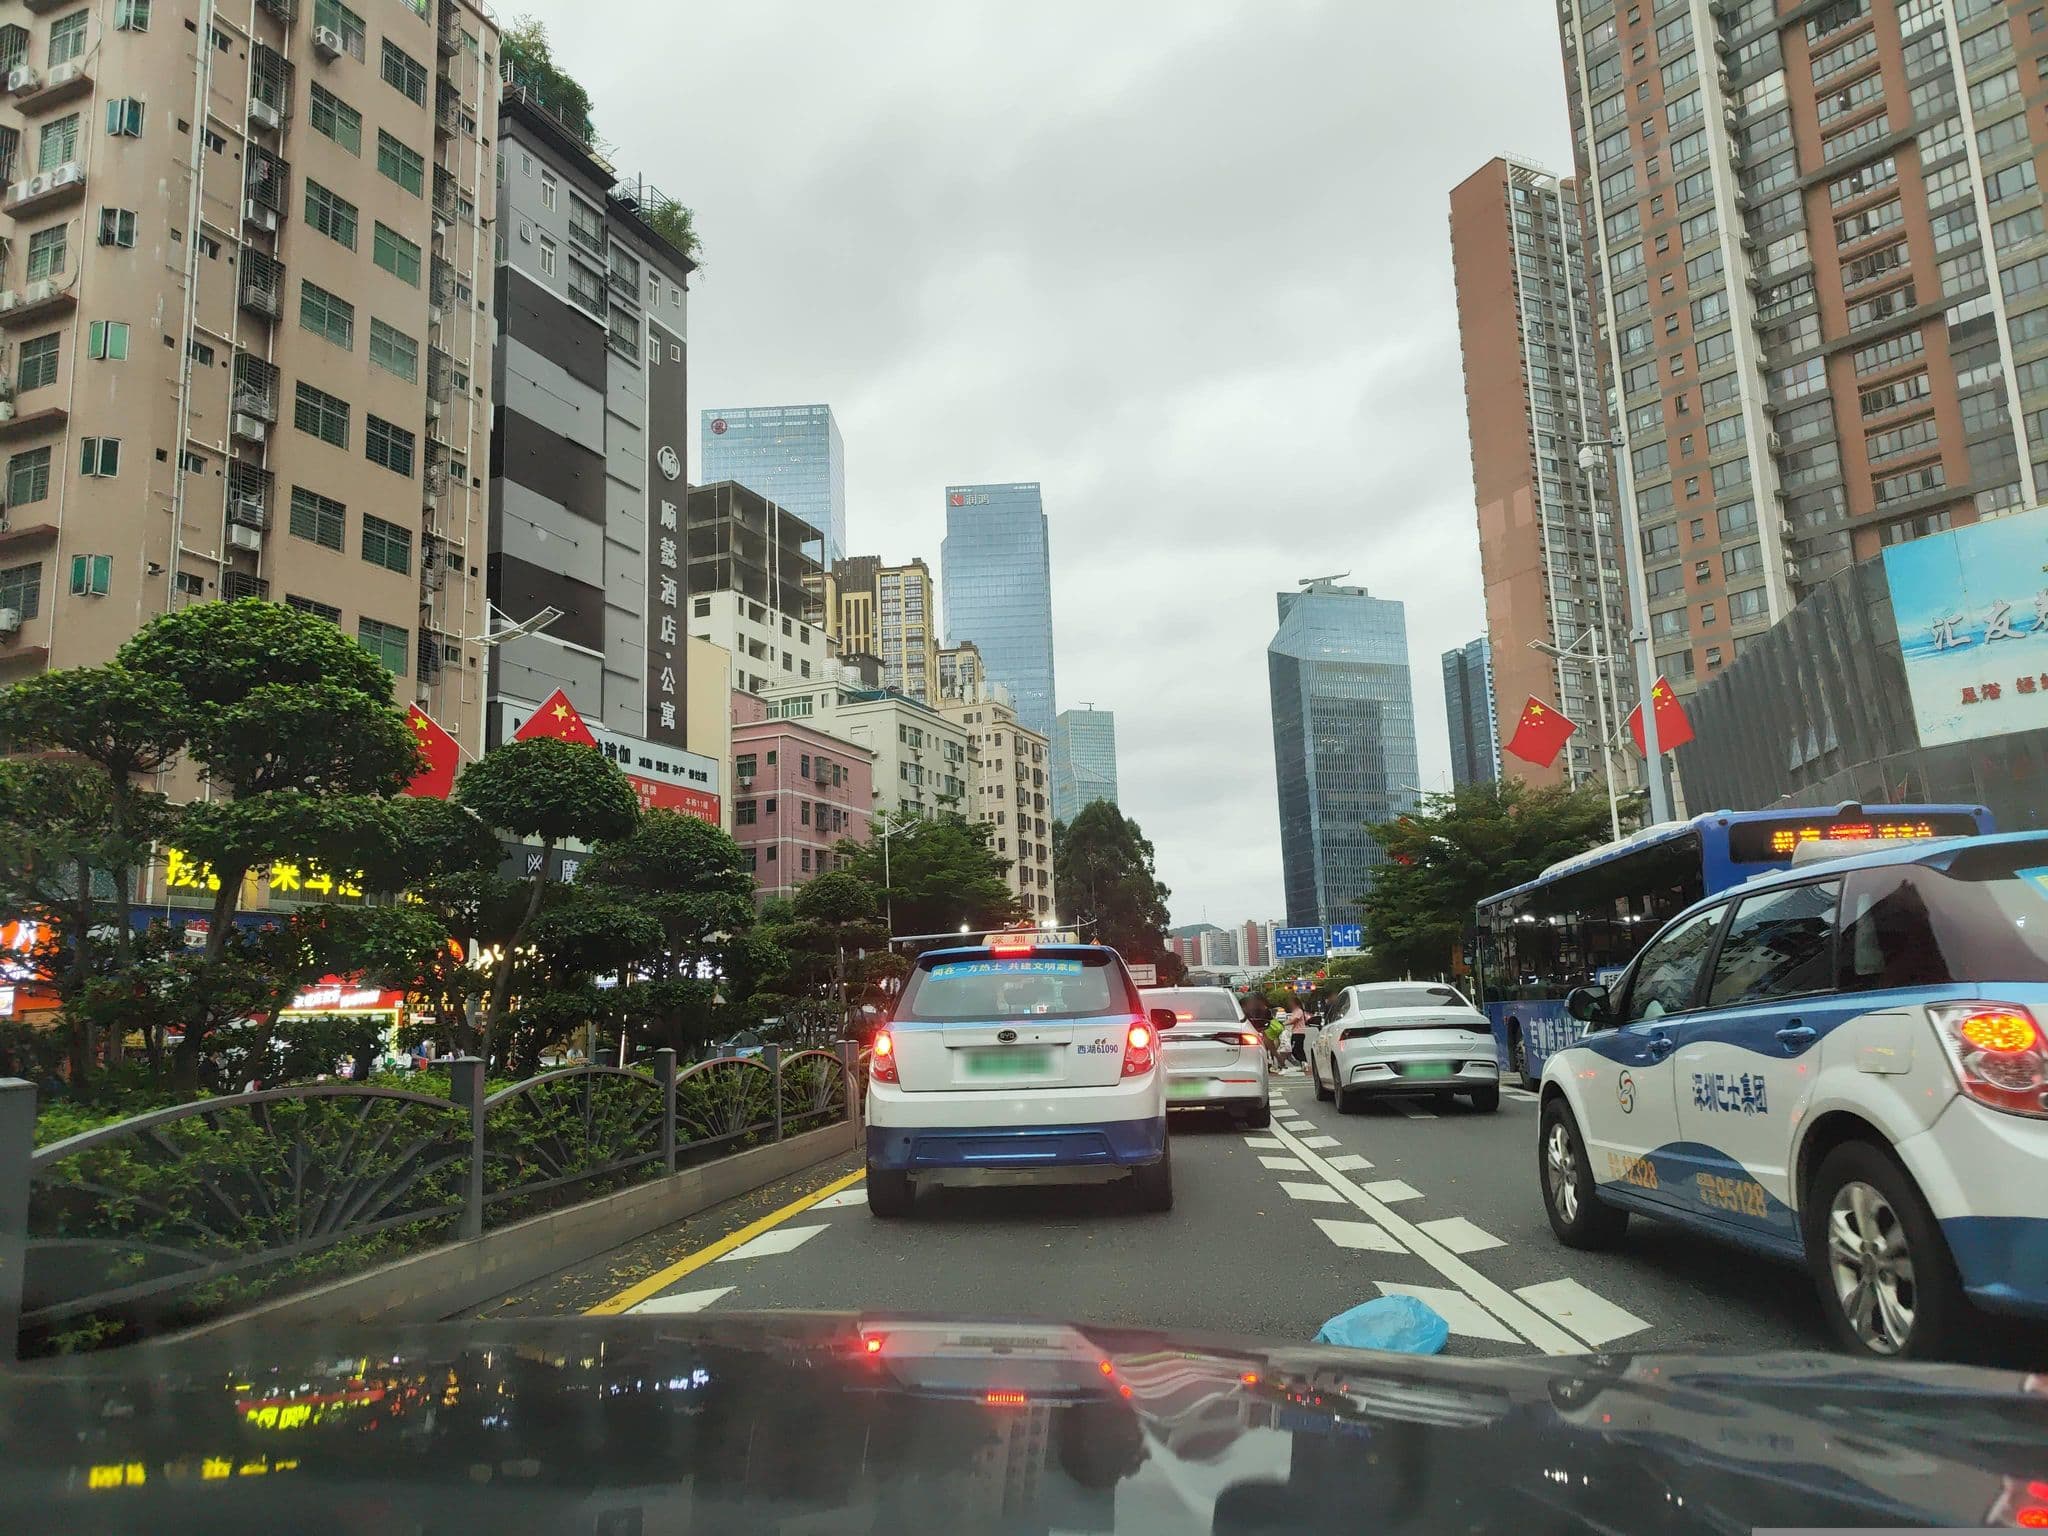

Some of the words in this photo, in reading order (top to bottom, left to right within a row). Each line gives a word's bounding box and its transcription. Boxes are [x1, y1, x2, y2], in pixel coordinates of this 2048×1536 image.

[992, 935, 1026, 944] 深圳
[1034, 934, 1067, 944] TAXI
[1077, 1044, 1119, 1054] 西湖61090
[1692, 1072, 1768, 1116] 深圳巴士集团
[1715, 1174, 1767, 1218] 95128
